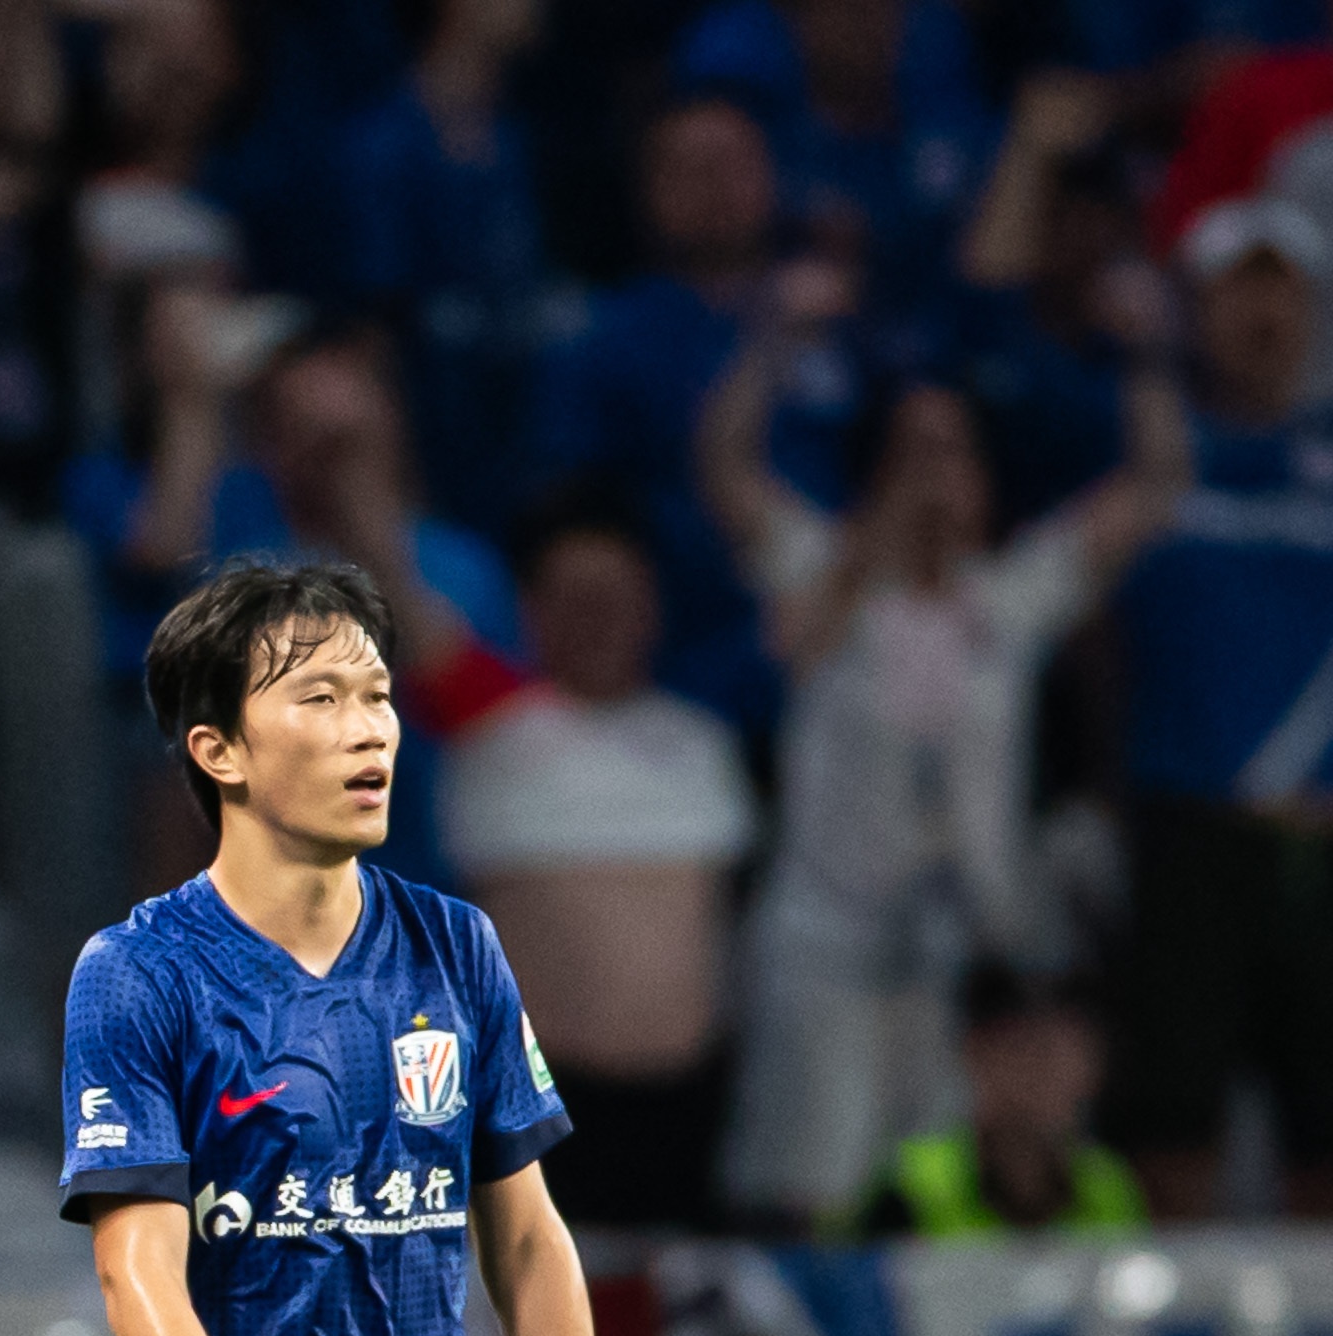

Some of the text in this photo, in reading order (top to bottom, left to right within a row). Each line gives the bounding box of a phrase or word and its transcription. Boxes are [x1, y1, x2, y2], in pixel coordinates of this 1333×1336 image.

[275, 1167, 455, 1219] 交通銀行
[255, 1221, 309, 1239] BANK
[313, 1219, 341, 1233] OF
